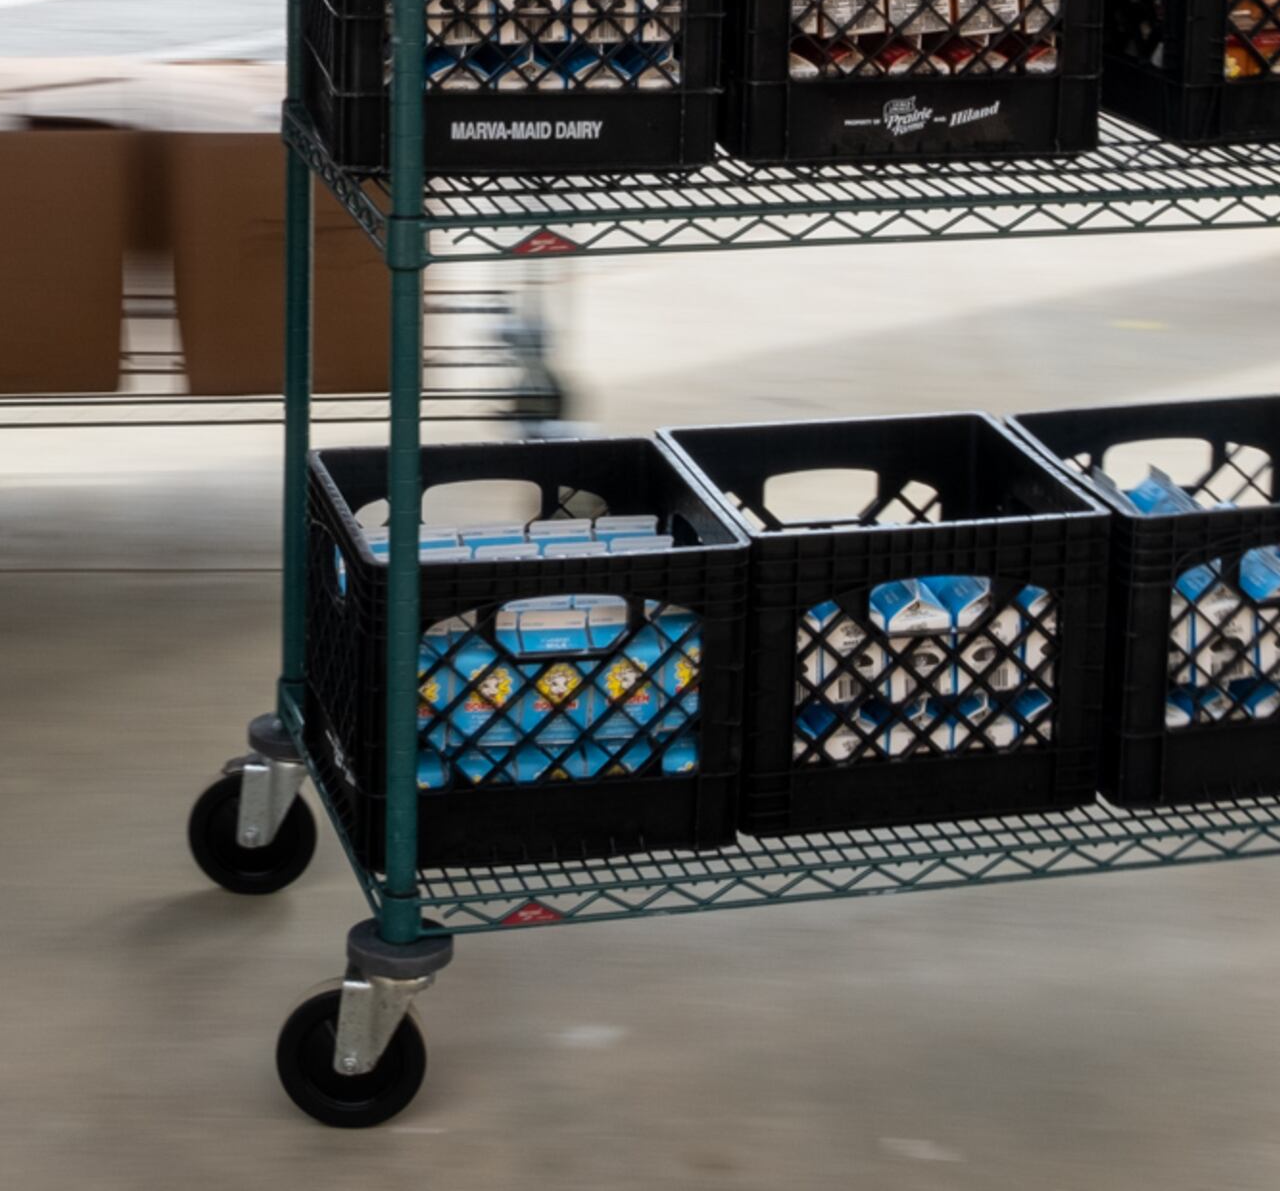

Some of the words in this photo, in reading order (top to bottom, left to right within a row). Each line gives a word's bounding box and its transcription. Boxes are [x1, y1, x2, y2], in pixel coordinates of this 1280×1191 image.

[887, 106, 933, 130] Prairie
[949, 100, 1000, 127] Hiland
[451, 121, 552, 140] MARVA-MAID
[555, 121, 603, 139] DAIRY
